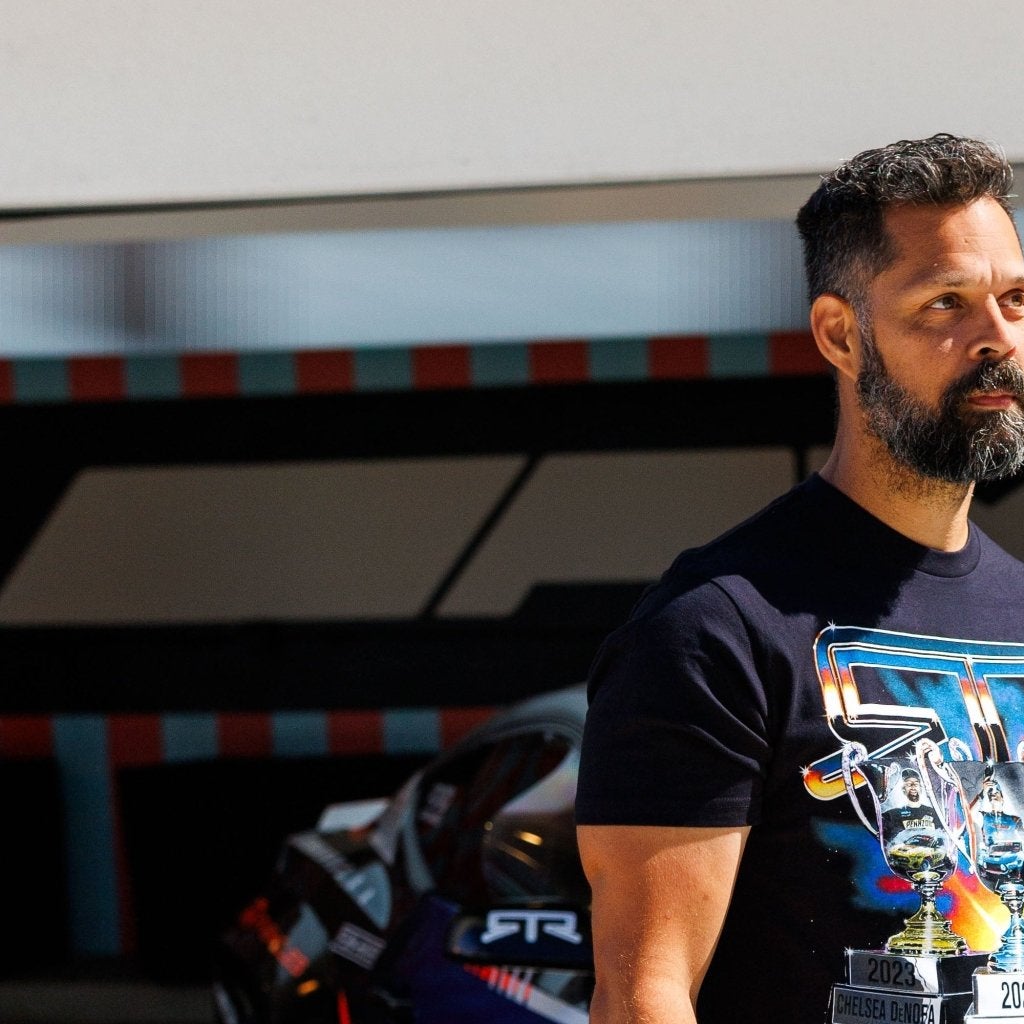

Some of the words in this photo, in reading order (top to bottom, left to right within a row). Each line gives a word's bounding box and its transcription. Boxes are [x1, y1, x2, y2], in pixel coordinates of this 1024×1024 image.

[481, 909, 582, 944] RTR
[868, 957, 916, 987] 2023
[836, 993, 886, 1019] CHELSEA
